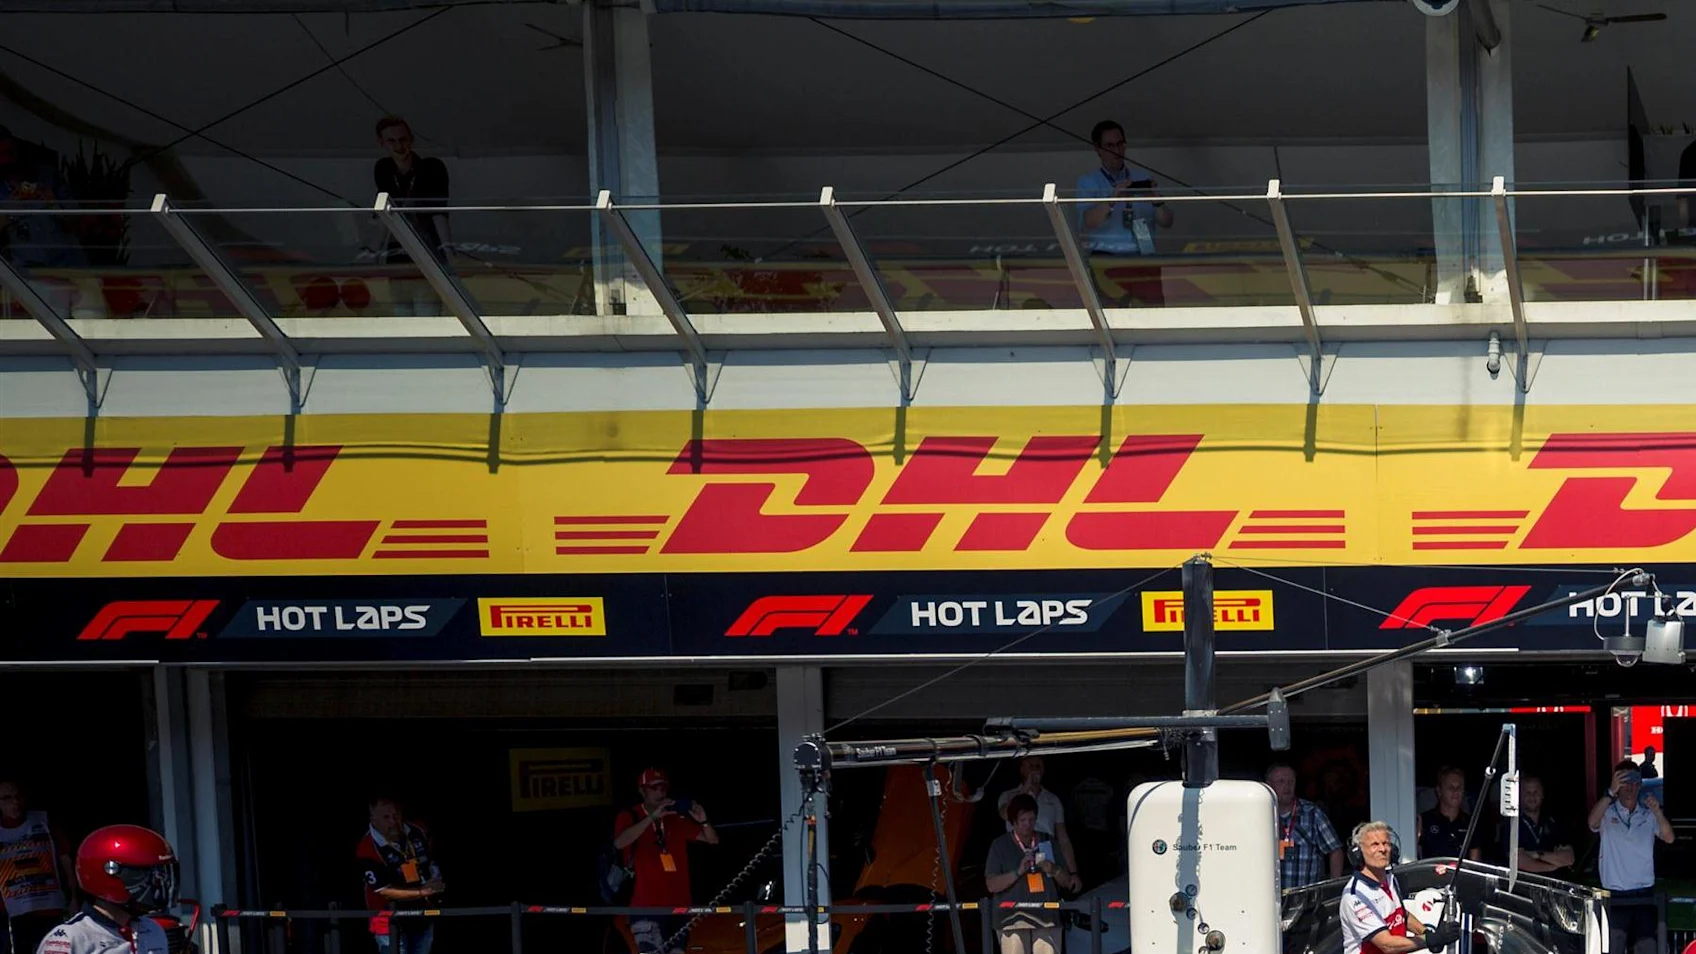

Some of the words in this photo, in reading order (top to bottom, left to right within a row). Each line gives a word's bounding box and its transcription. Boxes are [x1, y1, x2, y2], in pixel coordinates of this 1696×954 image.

[0, 445, 382, 563] HL
[659, 434, 1239, 553] DHL
[490, 604, 593, 628] PIRELLI
[911, 601, 987, 627] HOT
[1153, 598, 1261, 623] PILLI
[1568, 591, 1640, 618] HOT
[257, 605, 328, 631] HOT
[1216, 843, 1237, 852] Team
